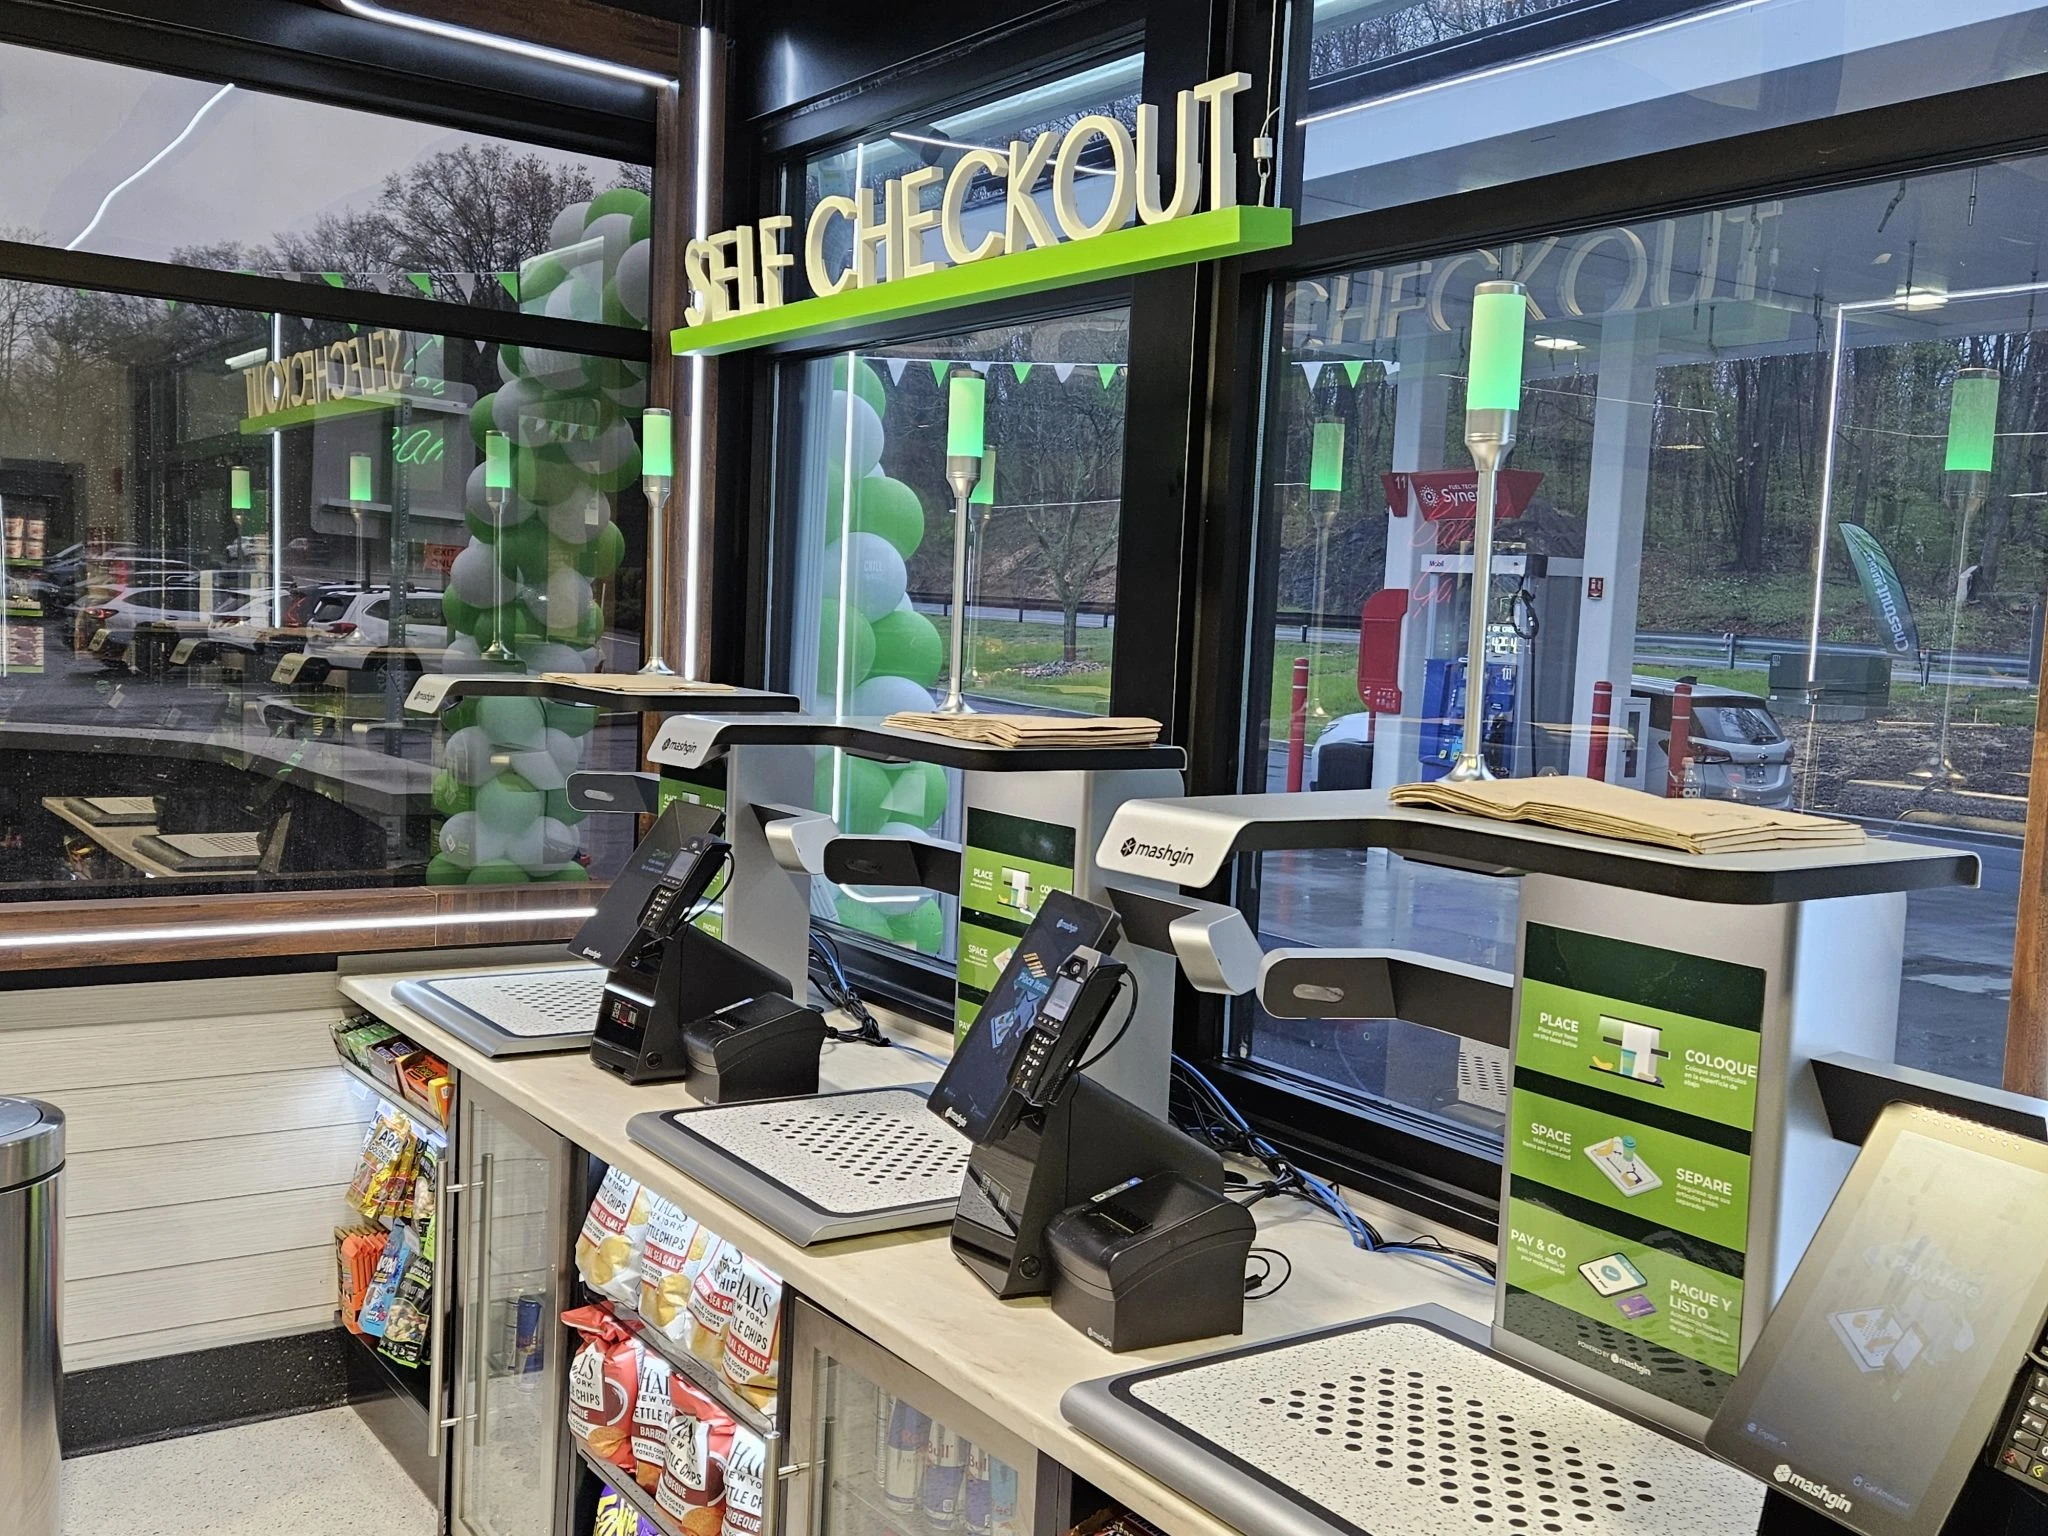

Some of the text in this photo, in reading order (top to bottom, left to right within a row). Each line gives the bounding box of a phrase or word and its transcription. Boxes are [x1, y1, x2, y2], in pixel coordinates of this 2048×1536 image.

[684, 71, 1252, 327] SELF CHECKOUT
[1395, 475, 1407, 489] 11
[1875, 584, 1909, 651] Chestnut
[669, 740, 697, 755] mashgin
[1135, 843, 1195, 867] mashgin
[973, 868, 993, 881] PLACE
[968, 944, 988, 958] SPACE
[1540, 1012, 1579, 1033] PLACE
[1685, 1049, 1758, 1078] COLOQUE
[1531, 1122, 1572, 1145] SPACE
[1676, 1167, 1733, 1196] SEPARE
[607, 1193, 627, 1215] CHIPS
[606, 1217, 624, 1233] SALT
[659, 1230, 686, 1251] CHIPS
[1511, 1229, 1566, 1259] PAY & GO
[662, 1255, 682, 1270] SALT
[719, 1277, 737, 1293] HIP
[1670, 1279, 1733, 1312] PAGUE Y
[709, 1293, 721, 1308] SEA
[722, 1301, 733, 1313] SA
[1670, 1295, 1709, 1320] LISTO
[745, 1308, 765, 1329] YORK
[743, 1324, 768, 1350] CHIPS
[736, 1345, 748, 1361] SEA
[748, 1354, 766, 1371] SALT
[1619, 1357, 1652, 1376] mashgin
[575, 1389, 600, 1407] CHIPS
[661, 1397, 671, 1407] YO
[634, 1406, 664, 1422] ETTLE
[2021, 1414, 2031, 1425] 7
[653, 1447, 665, 1456] COOK
[749, 1478, 762, 1490] YO
[1789, 1473, 1853, 1513] mashgin
